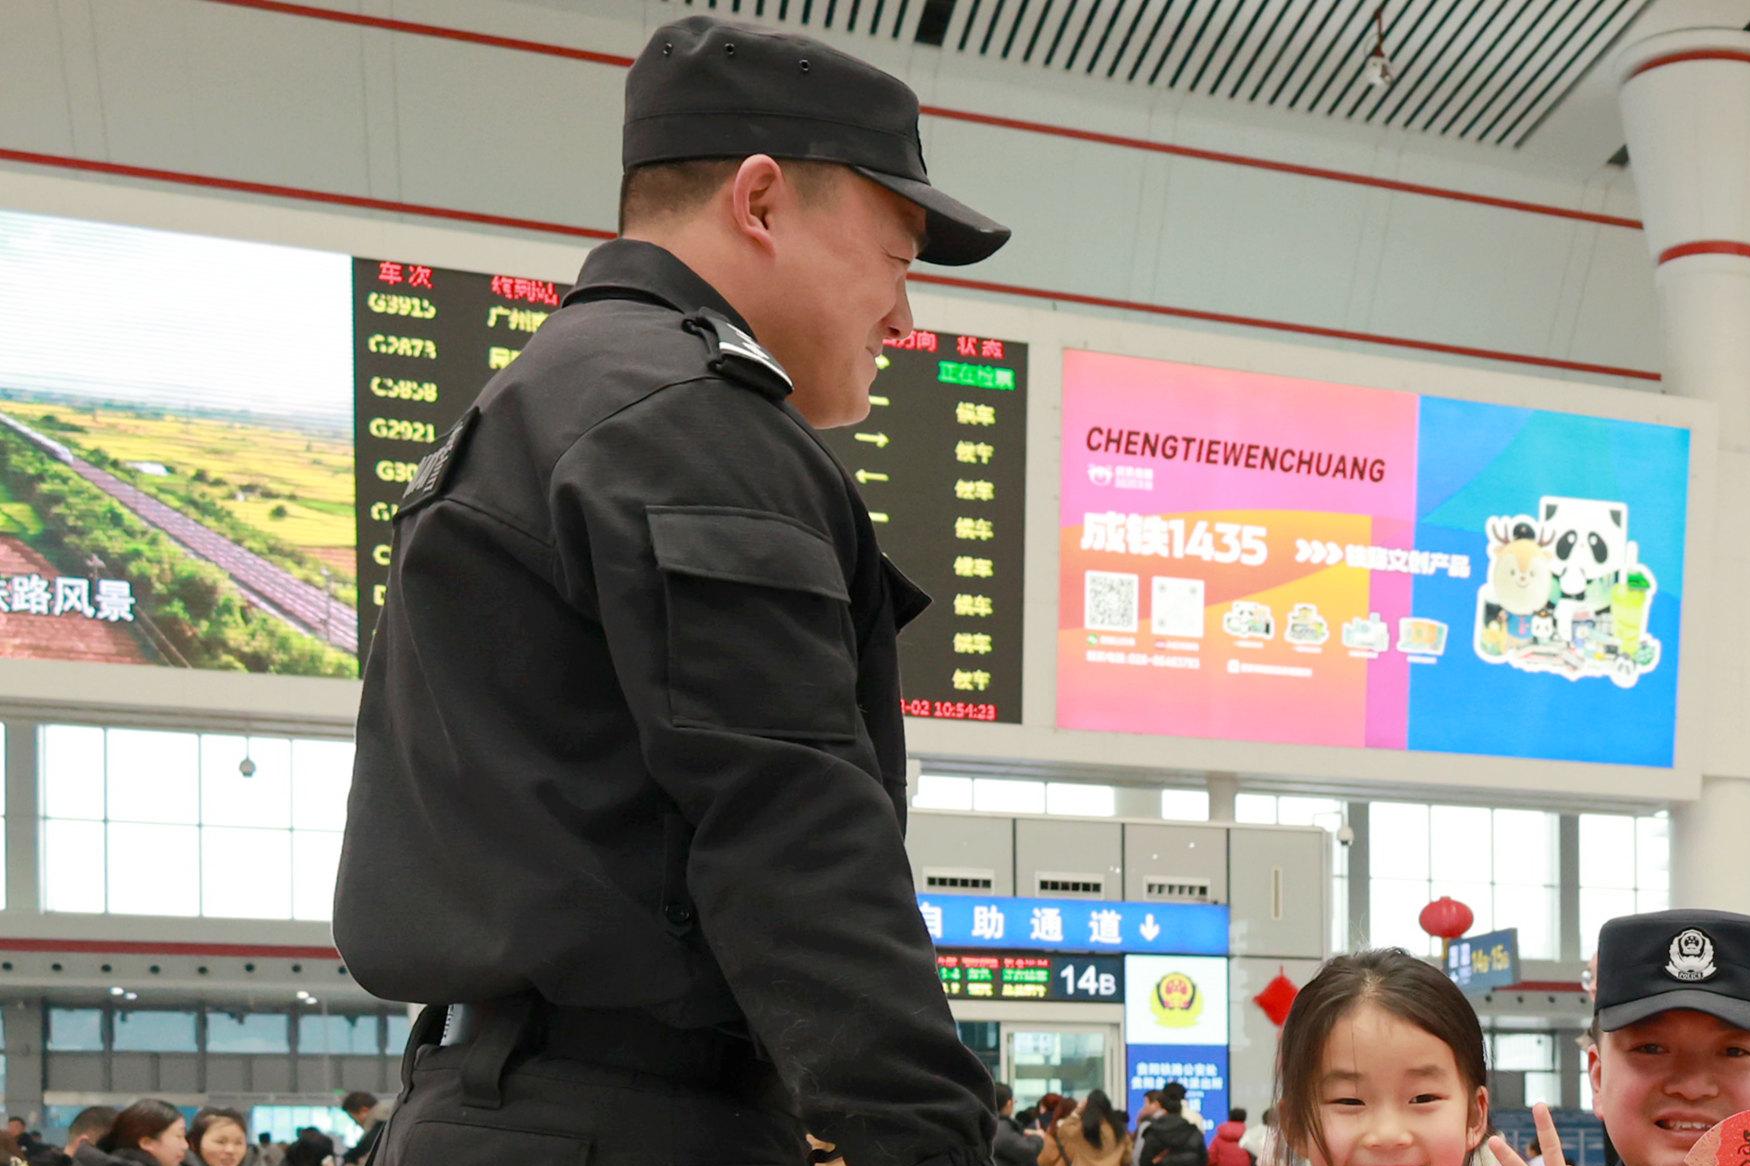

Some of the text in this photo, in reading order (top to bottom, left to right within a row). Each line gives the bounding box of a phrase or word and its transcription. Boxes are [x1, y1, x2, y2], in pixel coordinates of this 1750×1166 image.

[368, 417, 436, 444] G2921
[1086, 426, 1386, 483] CHENGTIEWENCHUANG
[1060, 964, 1117, 997] 14B
